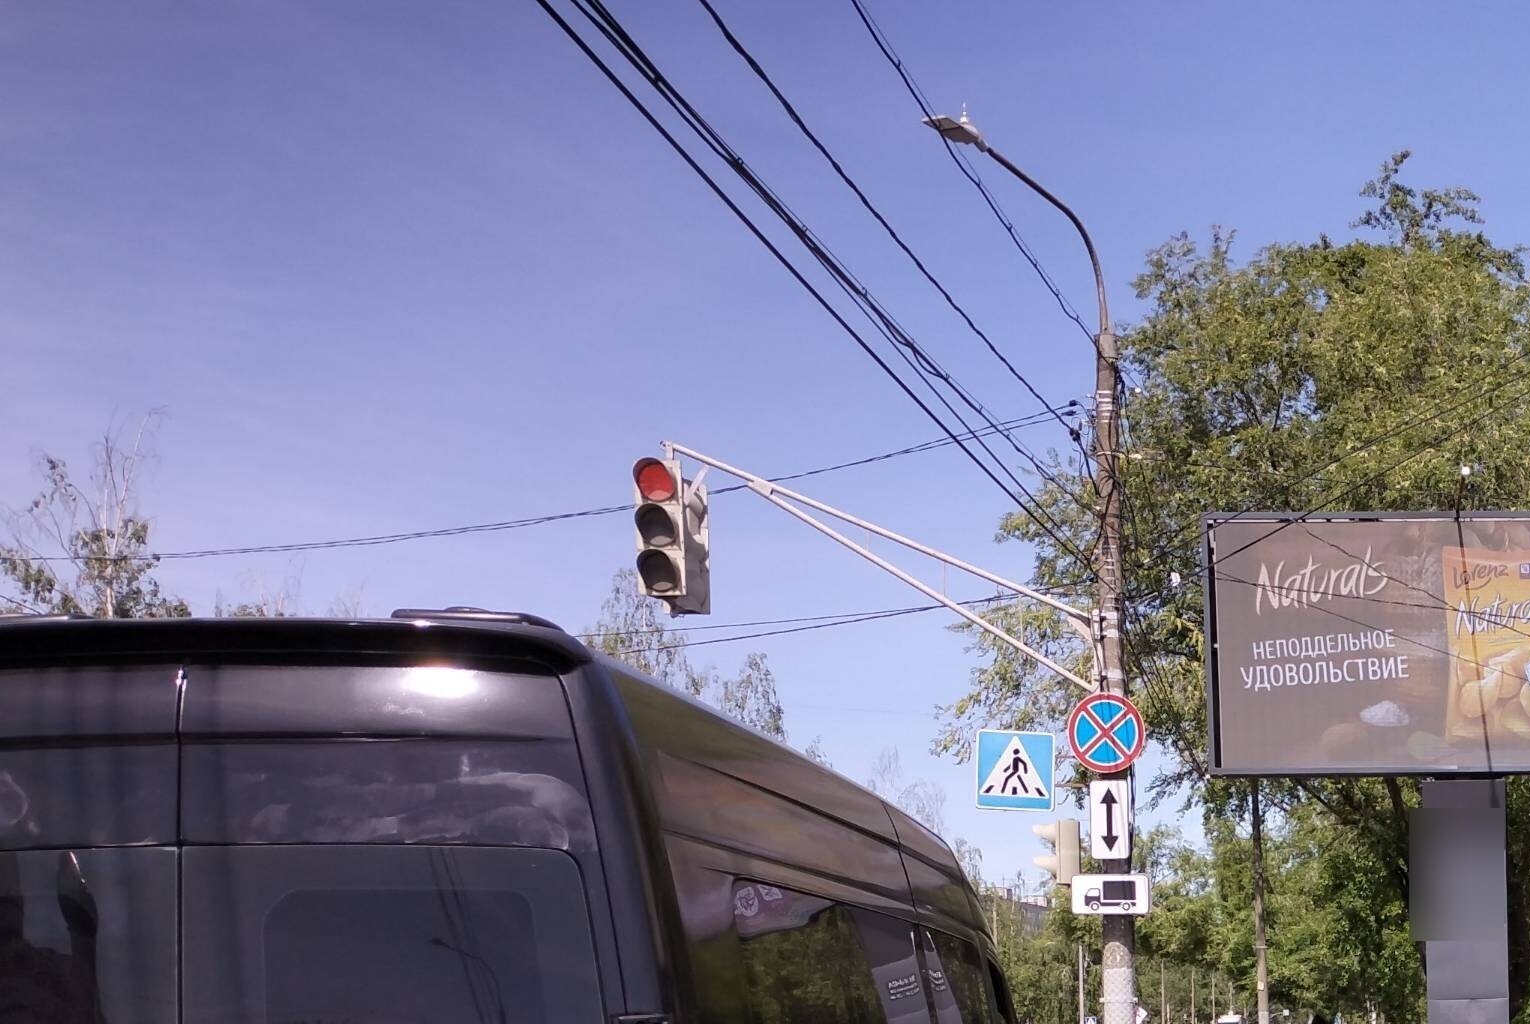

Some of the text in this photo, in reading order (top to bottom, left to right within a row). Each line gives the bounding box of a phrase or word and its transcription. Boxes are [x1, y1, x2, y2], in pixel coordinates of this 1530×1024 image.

[1256, 544, 1388, 616] Naturals
[1453, 563, 1509, 590] Lorenz
[1252, 629, 1396, 660] НЕПОДДЕЛЬНОЕ
[1240, 655, 1410, 692] УДОВОЛЬСТВИЕ
